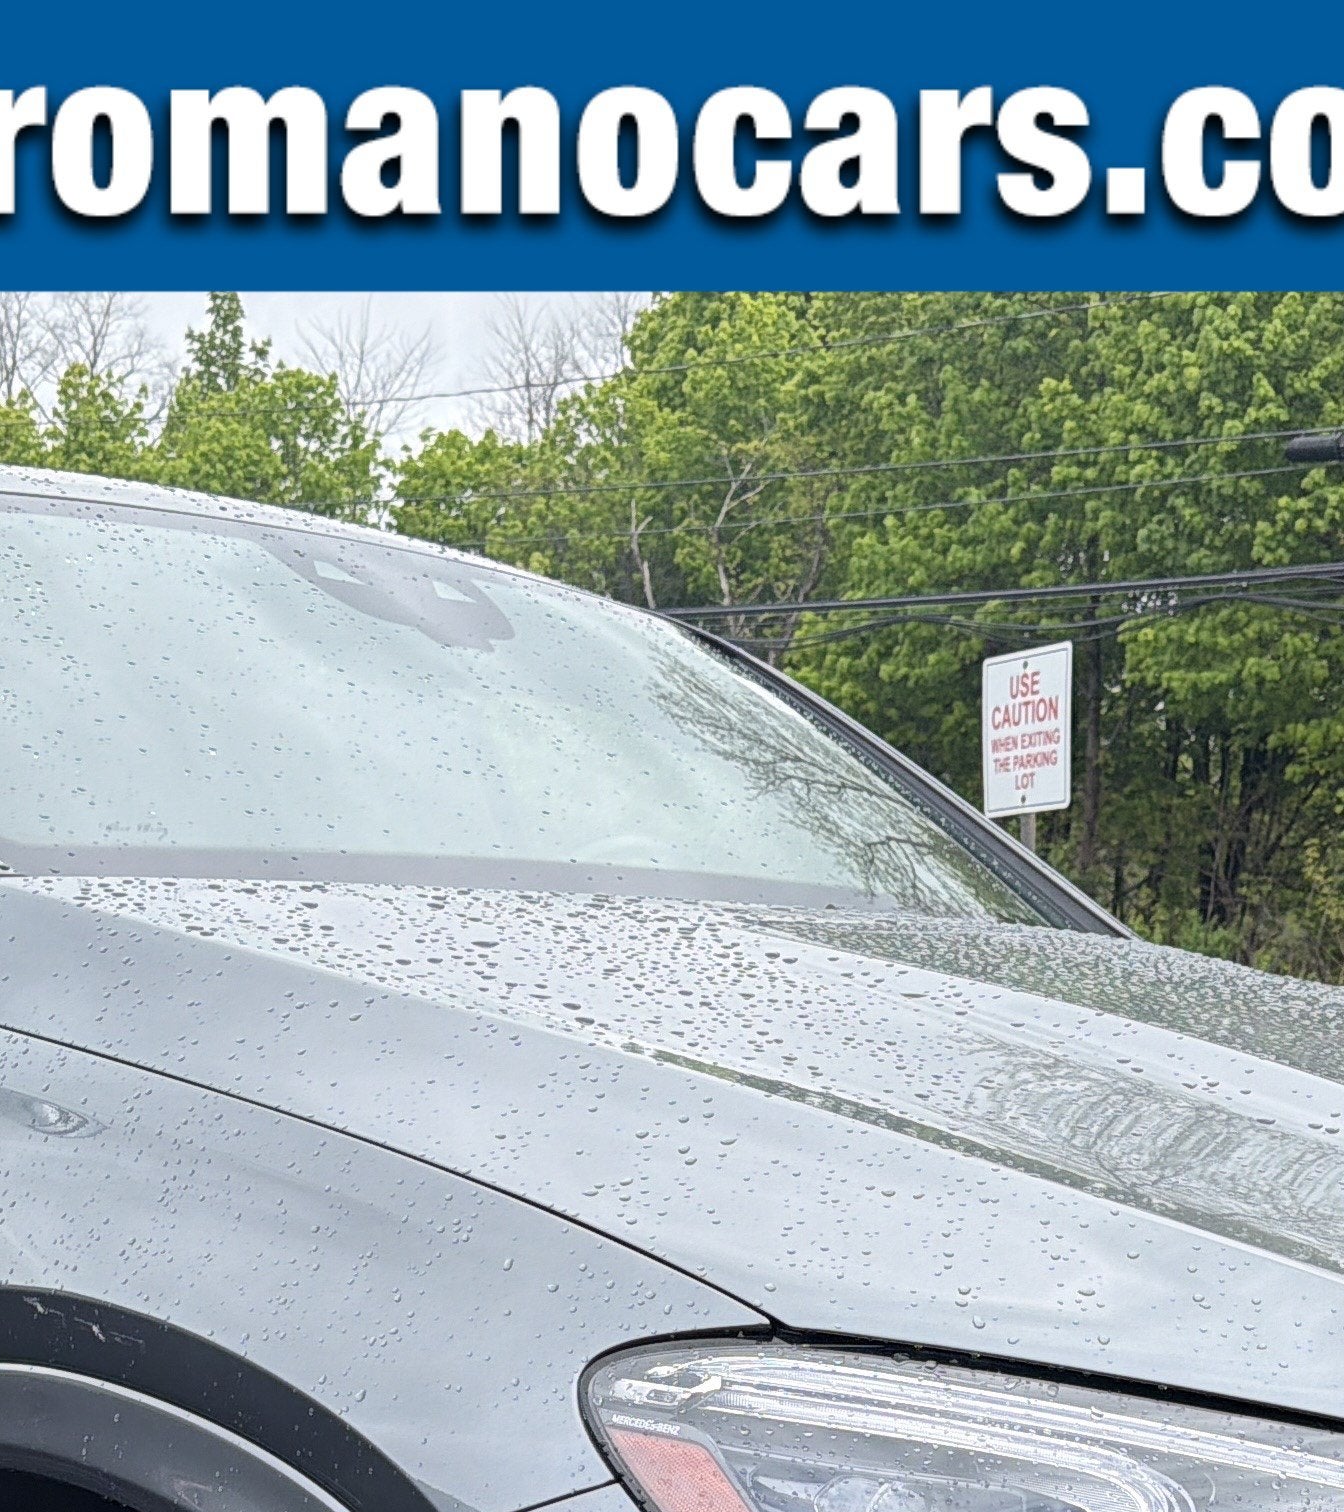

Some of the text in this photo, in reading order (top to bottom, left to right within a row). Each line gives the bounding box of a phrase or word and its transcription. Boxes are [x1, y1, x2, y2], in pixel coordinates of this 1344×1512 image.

[1009, 671, 1041, 699] USE
[992, 695, 1059, 730] CAUTION
[991, 728, 1060, 754] WHEN EXITING
[993, 750, 1058, 774] THE PARKING
[1014, 773, 1036, 790] LOT
[611, 1413, 681, 1436] MERCEDES-BENZ
